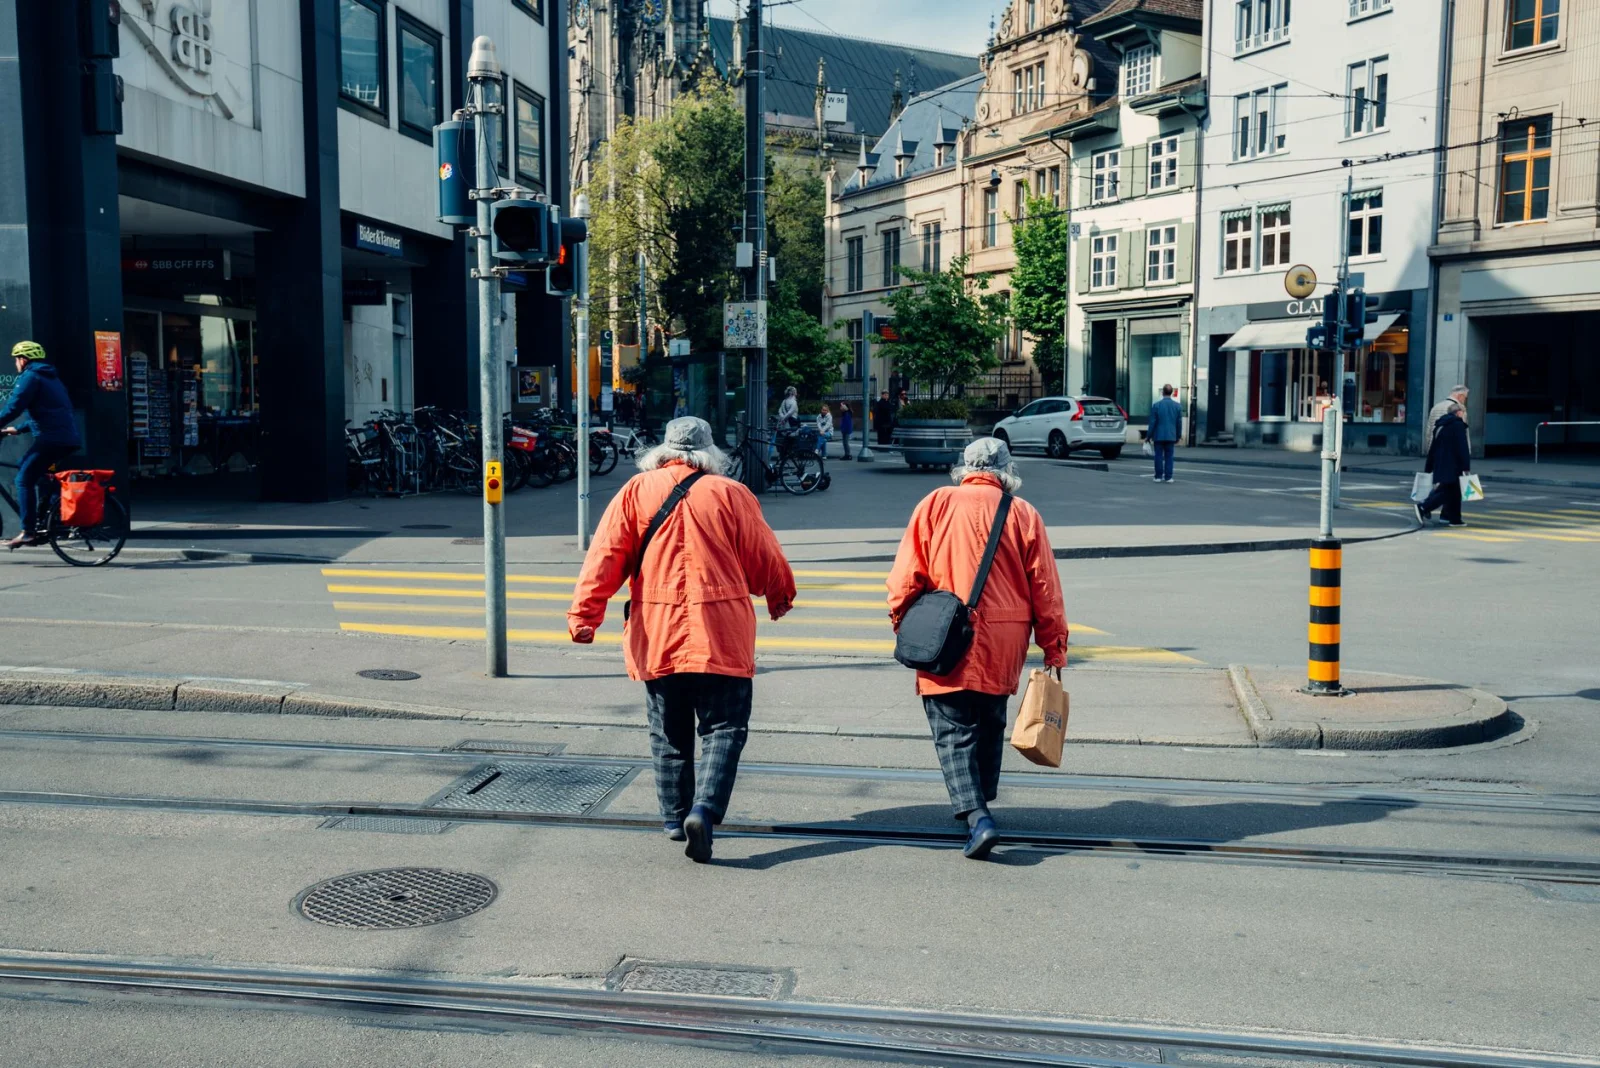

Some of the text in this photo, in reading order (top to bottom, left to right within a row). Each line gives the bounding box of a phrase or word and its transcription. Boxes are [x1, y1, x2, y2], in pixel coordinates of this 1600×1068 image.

[1070, 224, 1081, 235] 30
[152, 260, 214, 269] SBB CFF FFS
